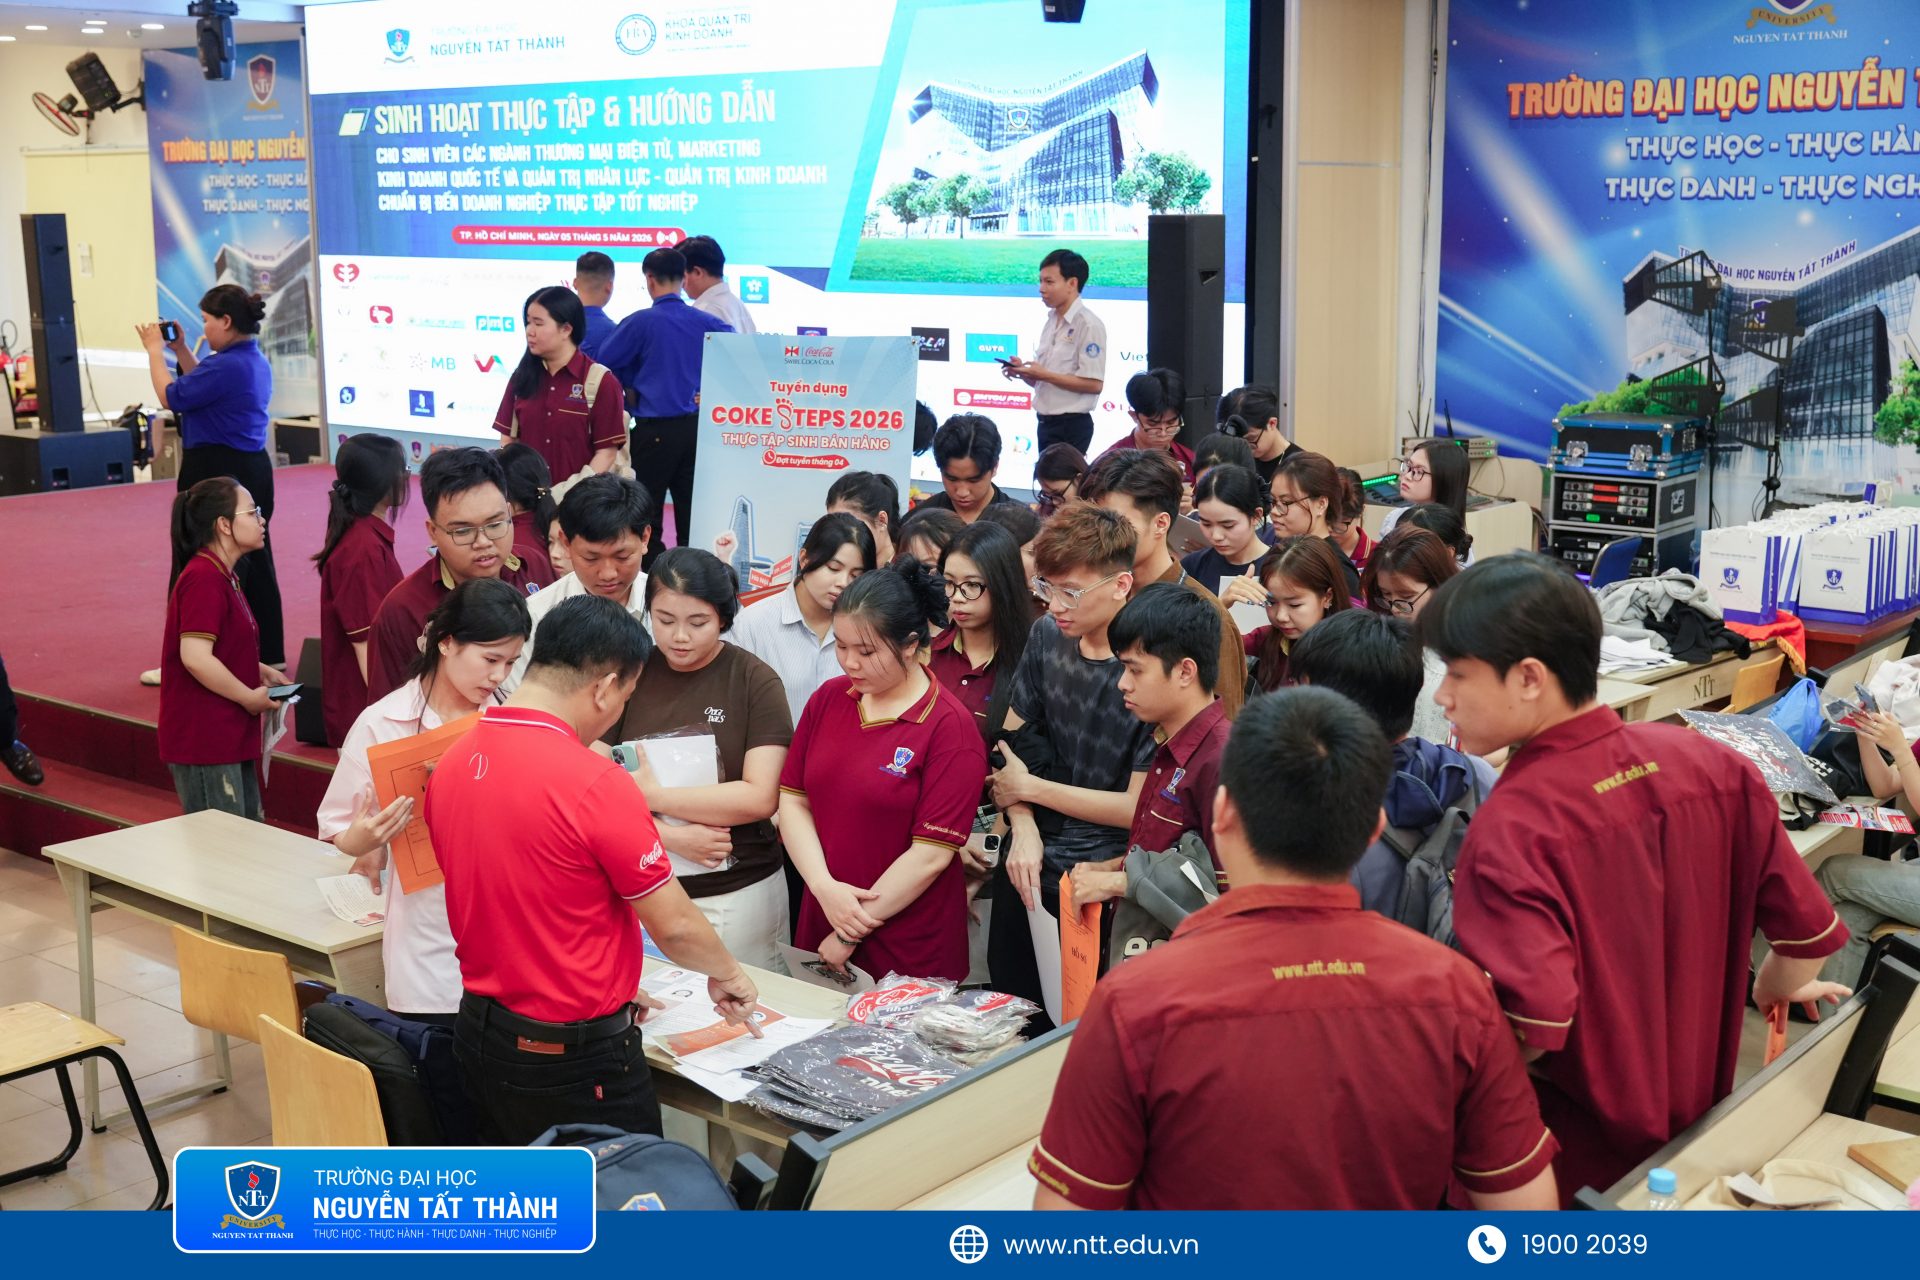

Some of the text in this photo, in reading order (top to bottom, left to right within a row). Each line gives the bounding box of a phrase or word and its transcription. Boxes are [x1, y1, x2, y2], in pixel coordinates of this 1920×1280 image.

[1733, 29, 1848, 44] NGUYEN TAT THANH
[1507, 56, 1906, 122] TRƯỜNG ĐẠI HỌC NGUYỄN
[374, 79, 776, 138] SINH HOẠT THỰC TẬP & HƯỚNG DẪN
[163, 136, 207, 162] TRƯỜNG
[210, 140, 229, 166] ĐẠI
[232, 139, 254, 165] HỌC
[376, 147, 400, 165] CHO
[402, 146, 430, 164] SINH
[432, 143, 460, 163] VIÊN
[463, 142, 486, 163] CÁC
[489, 142, 531, 163] NGÀNH
[534, 142, 584, 162] THƯƠNG
[588, 142, 613, 164] MẠI
[617, 139, 649, 164] ĐIỆN
[677, 138, 761, 159] MARKETING
[1626, 134, 1698, 162] THỰC
[1704, 133, 1764, 162] HỌC
[1786, 130, 1864, 161] THỰC
[209, 174, 235, 190] THỰC
[237, 175, 258, 190] HỌC
[266, 174, 293, 190] THỰC
[377, 171, 406, 188] KINH
[408, 170, 448, 188] DOANH
[450, 166, 481, 189] QUỐC
[484, 166, 500, 187] TẾ
[504, 167, 520, 186] VÀ
[522, 165, 556, 188] QUẢN
[559, 169, 581, 189] TRỊ
[585, 165, 621, 187] NHÂN
[625, 166, 650, 188] LỰC
[665, 163, 702, 186] QUẢN
[706, 167, 730, 188] TRỊ
[735, 166, 771, 184] KINH
[776, 165, 827, 184] DOANH
[1605, 177, 1674, 204] THỰC
[1680, 176, 1756, 200] DANH
[1781, 174, 1857, 204] THỰC
[203, 199, 228, 214] THỰC
[230, 199, 258, 212] DANH
[266, 199, 293, 215] THỰC
[378, 189, 699, 215] CHUẨN BỊ ĐẾN DOANH NGHIỆP THỰC TẬP TỐT NGHIỆP
[460, 231, 473, 240] TP.
[475, 230, 488, 240] HỒ
[490, 230, 507, 240] CHÍ
[508, 231, 536, 242] MINH,
[537, 231, 560, 241] NGÀY
[573, 231, 602, 242] THÁNG
[609, 231, 630, 242] NĂM
[1716, 262, 1732, 278] ĐẠI
[1736, 269, 1755, 281] HỌC
[1821, 240, 1857, 268] THÀNH
[431, 356, 456, 370] MB
[769, 380, 848, 398] Tuyển dụng
[711, 398, 905, 431] COKE STEPS 2026
[722, 432, 890, 450] THỰC TẬP SINH BÁN HÀNG
[776, 456, 788, 466] Đợt
[811, 456, 833, 468] tháng
[834, 458, 845, 466] 04
[1693, 673, 1716, 701] NTT
[1272, 959, 1366, 979] www.ntt.edu.vn
